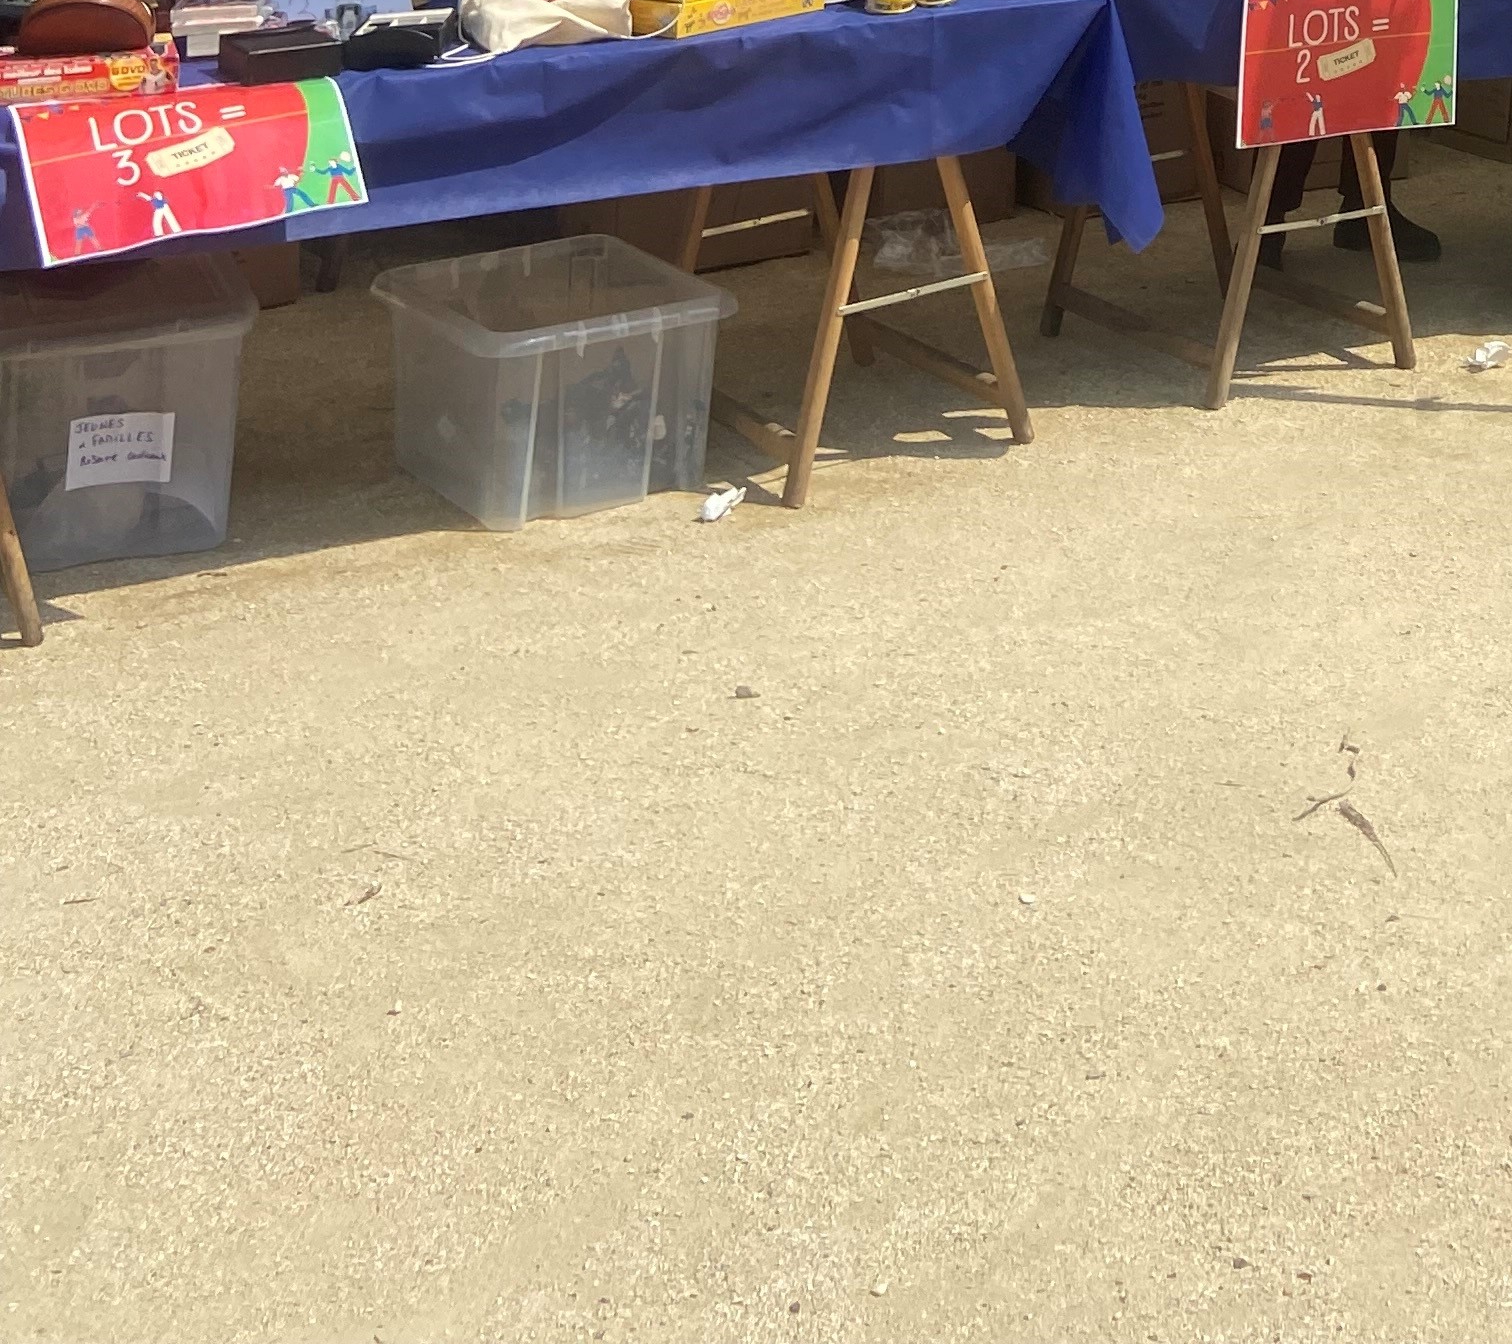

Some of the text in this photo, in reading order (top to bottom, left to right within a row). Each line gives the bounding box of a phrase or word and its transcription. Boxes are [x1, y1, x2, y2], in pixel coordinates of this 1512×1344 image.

[1288, 5, 1360, 48] LOTS
[121, 63, 145, 75] DVD
[1296, 49, 1360, 83] 2 TICKET
[88, 101, 203, 152] LOTS
[112, 141, 209, 187] 3 TICKET
